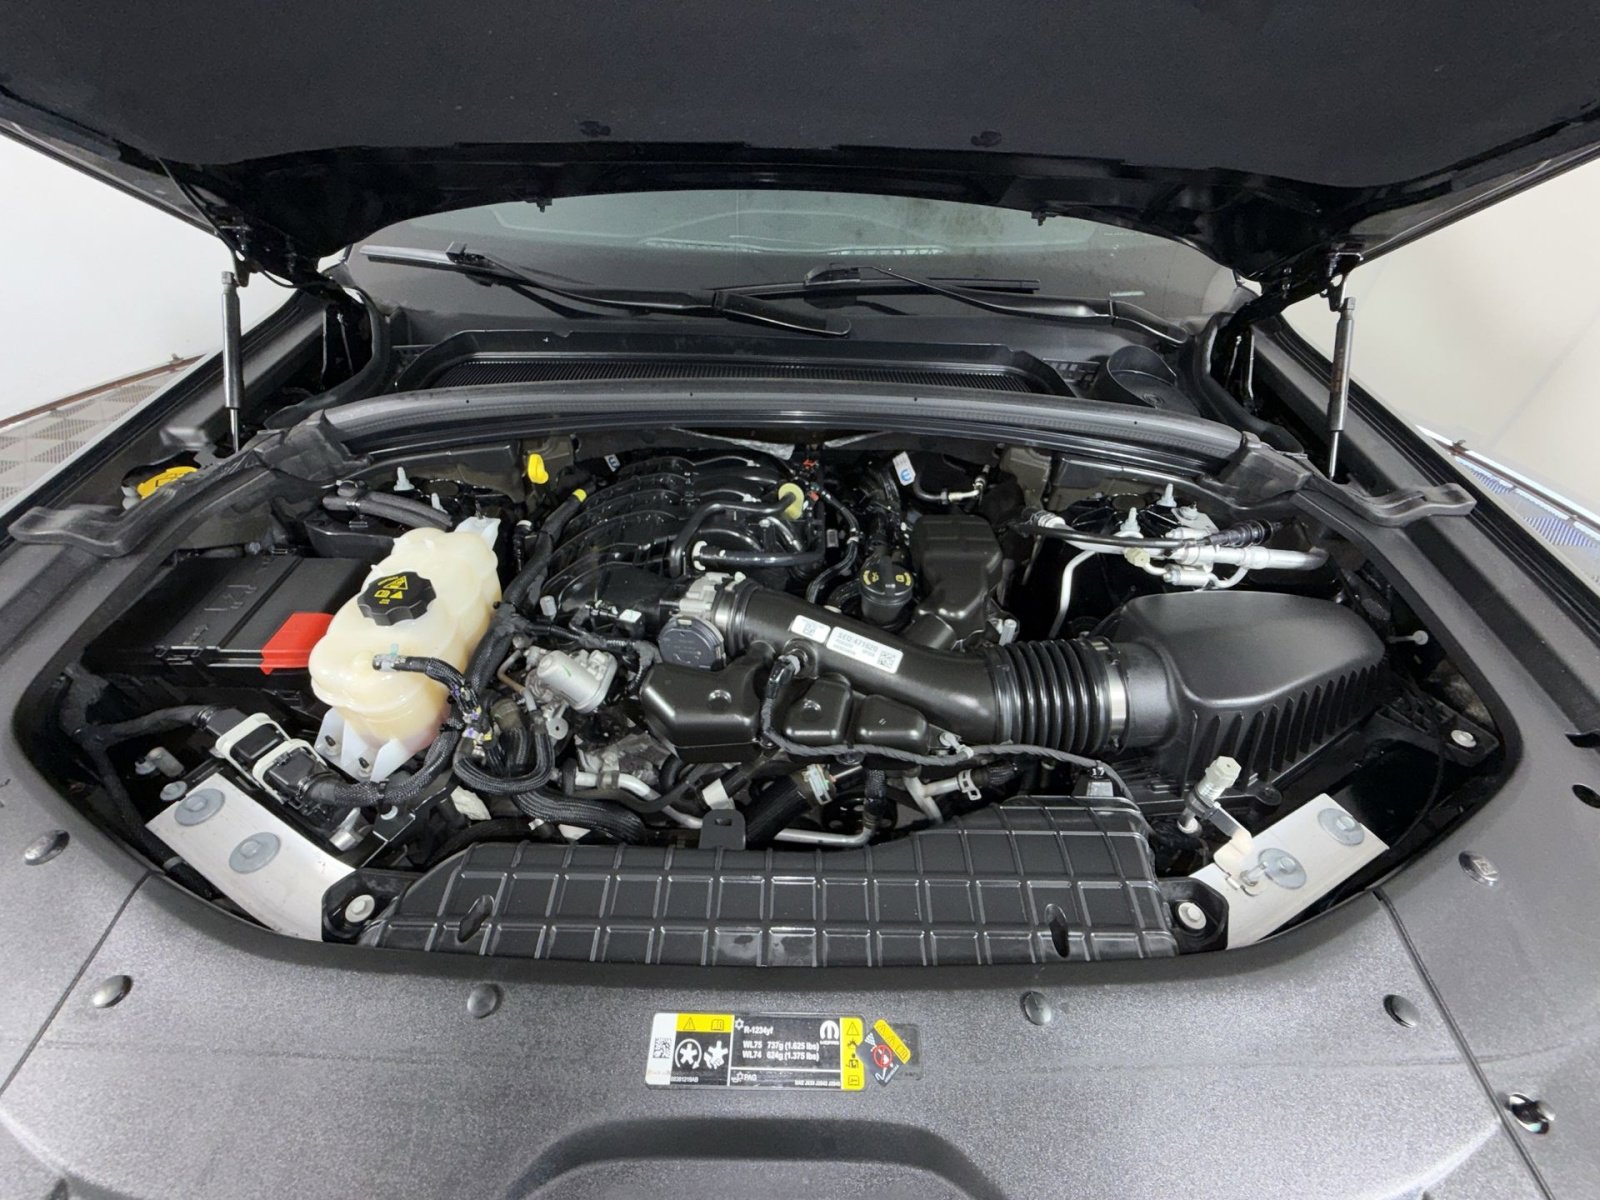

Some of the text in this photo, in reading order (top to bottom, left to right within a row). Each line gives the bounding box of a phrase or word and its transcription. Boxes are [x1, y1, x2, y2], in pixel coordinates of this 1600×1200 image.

[743, 1026, 774, 1036] R-1234yf
[742, 1040, 763, 1049] WL75
[767, 1041, 784, 1051] 737g
[784, 1041, 805, 1051] (1.625
[806, 1042, 820, 1052] lbs)
[742, 1050, 820, 1062] WL74 624g (1.375 lbs)
